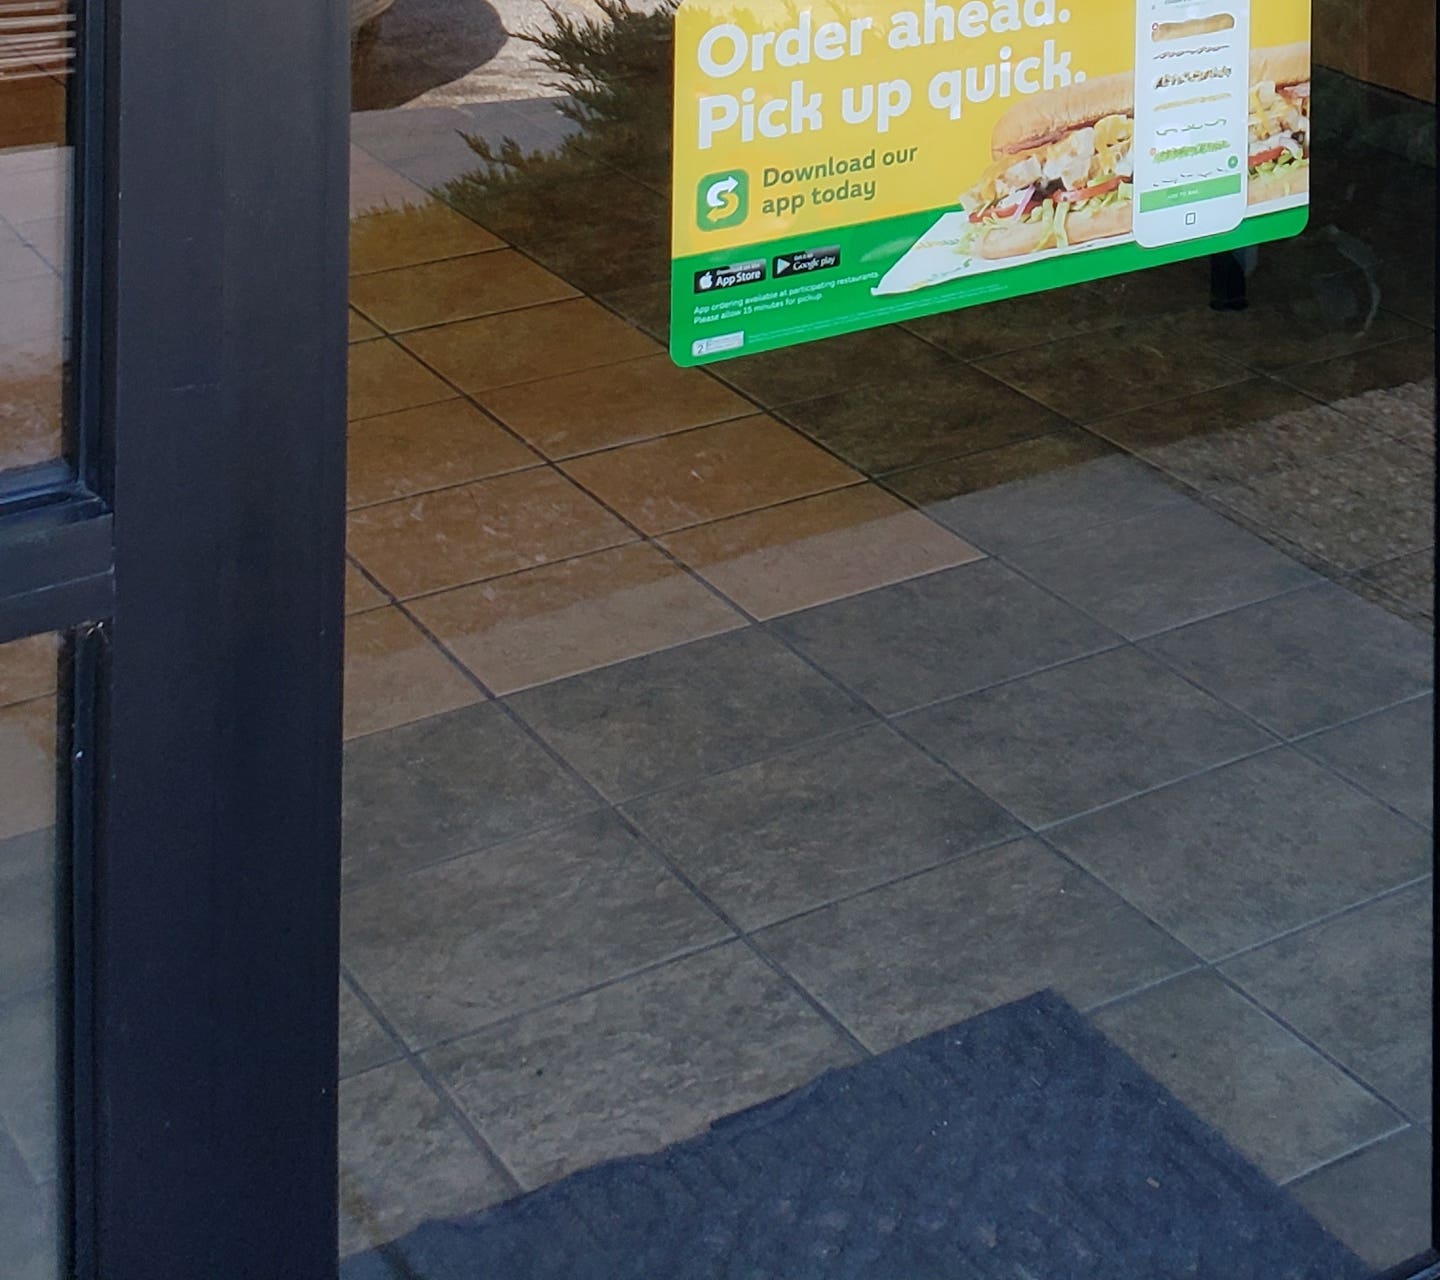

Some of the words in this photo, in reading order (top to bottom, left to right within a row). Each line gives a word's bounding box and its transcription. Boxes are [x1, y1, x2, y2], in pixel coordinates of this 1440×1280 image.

[697, 9, 872, 78] Order
[698, 80, 823, 150] Pick
[842, 77, 911, 132] up
[929, 39, 1086, 120] quick.
[763, 149, 876, 188] Download
[882, 146, 918, 167] our
[762, 193, 805, 217] app
[812, 180, 876, 207] today
[715, 273, 735, 287] App
[736, 269, 761, 282] Store
[793, 258, 819, 271] Google
[820, 255, 836, 266] play
[711, 298, 743, 312] ordering
[789, 279, 835, 297] participating
[754, 300, 784, 313] minutes
[785, 297, 796, 306] for
